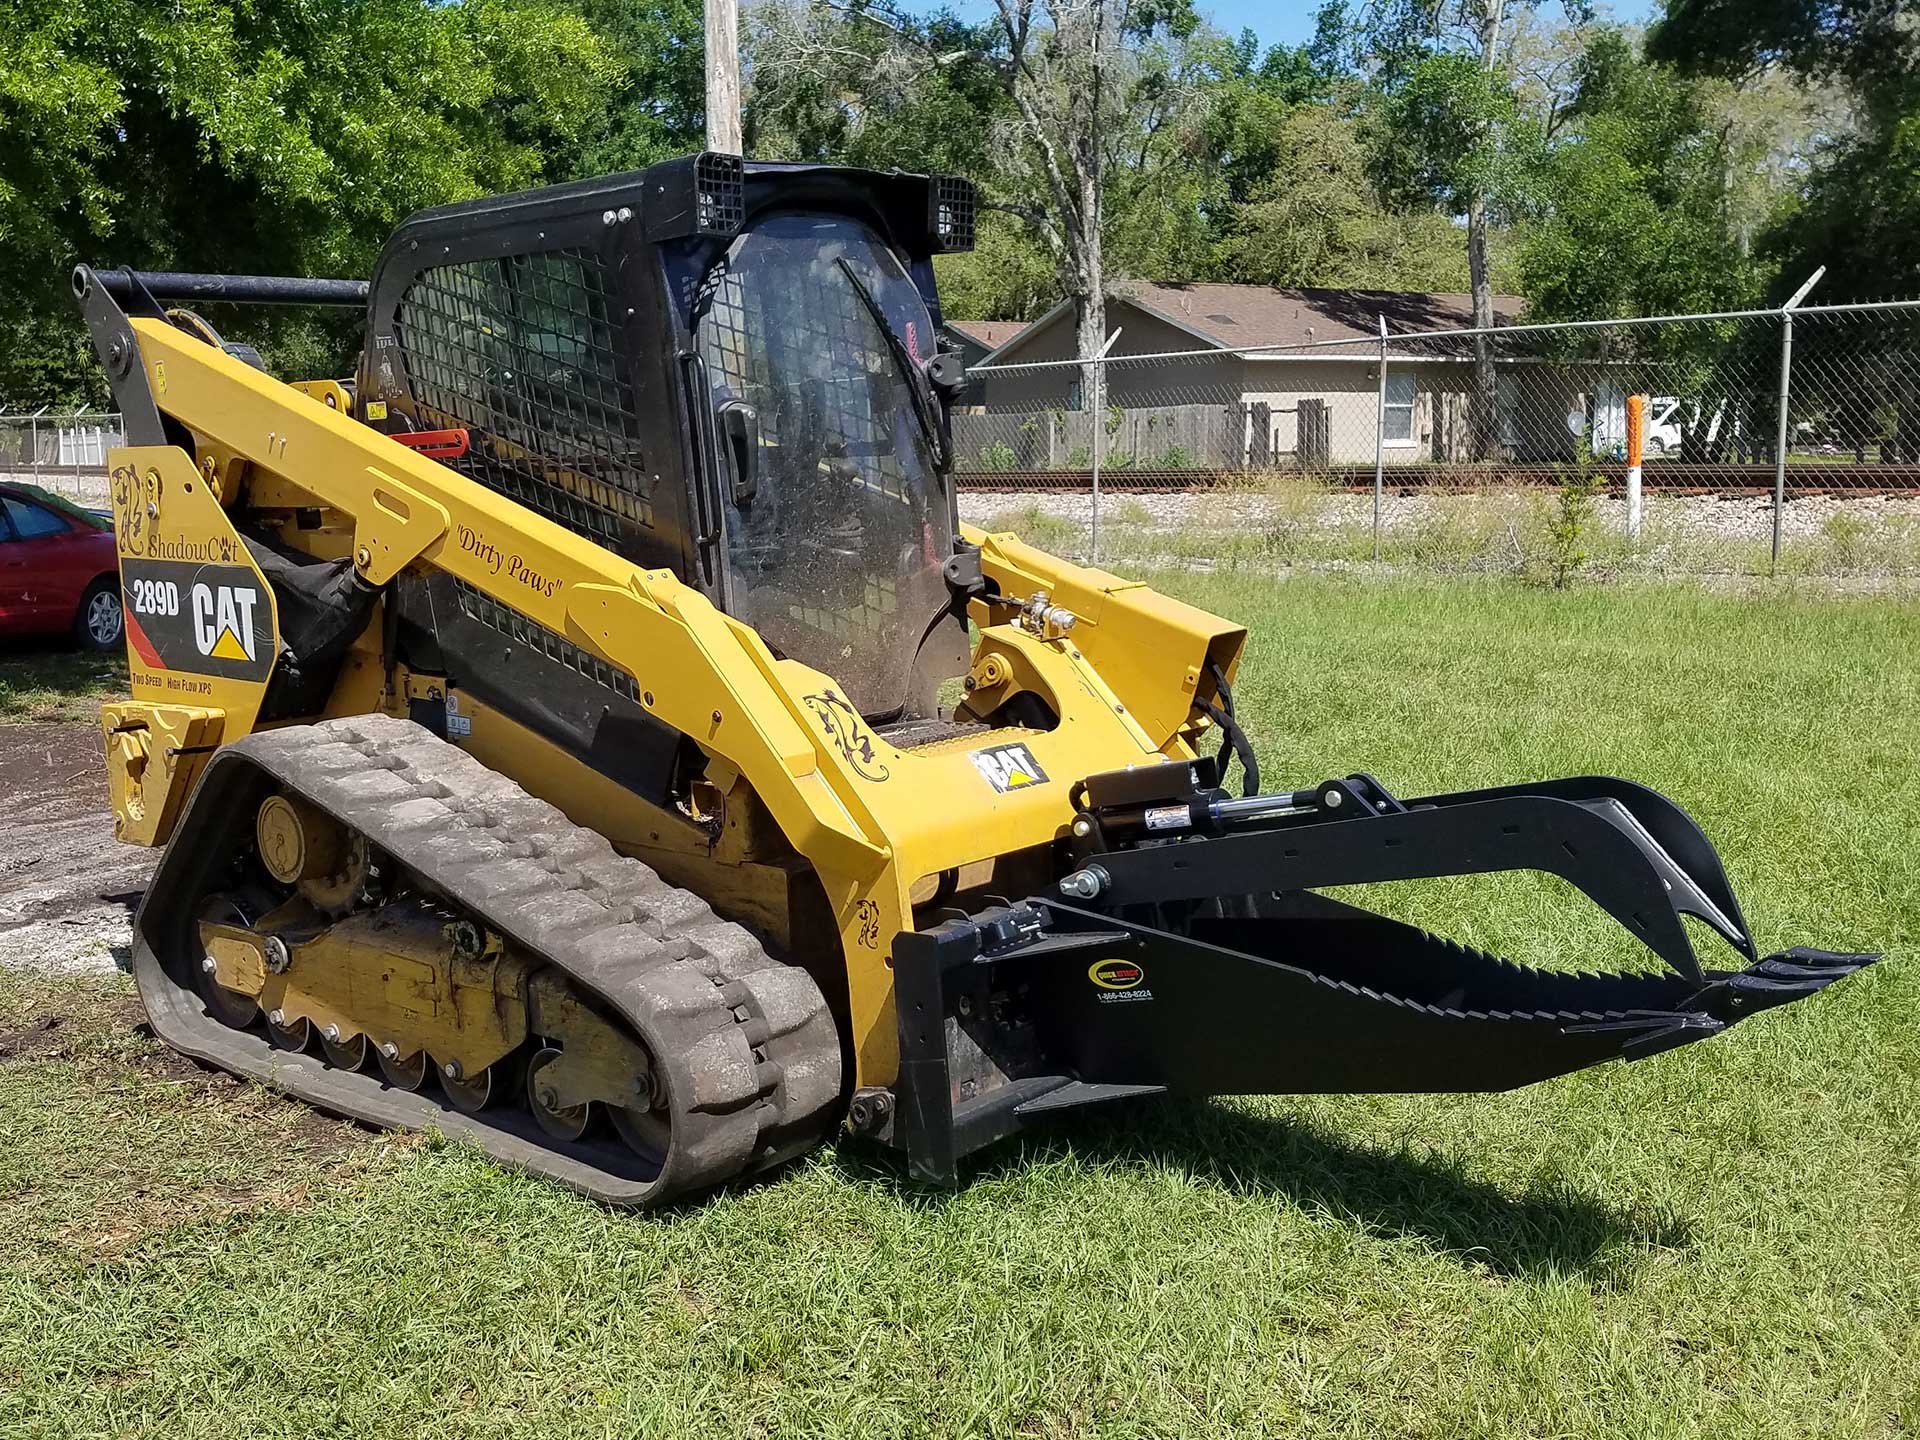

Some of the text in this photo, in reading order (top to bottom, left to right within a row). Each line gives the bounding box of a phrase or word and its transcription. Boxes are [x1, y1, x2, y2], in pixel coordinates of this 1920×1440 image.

[149, 535, 239, 562] ShadowCt
[133, 579, 179, 616] 289D
[192, 582, 257, 663] CAT
[198, 681, 212, 695] XPS
[977, 746, 1041, 790] CAT
